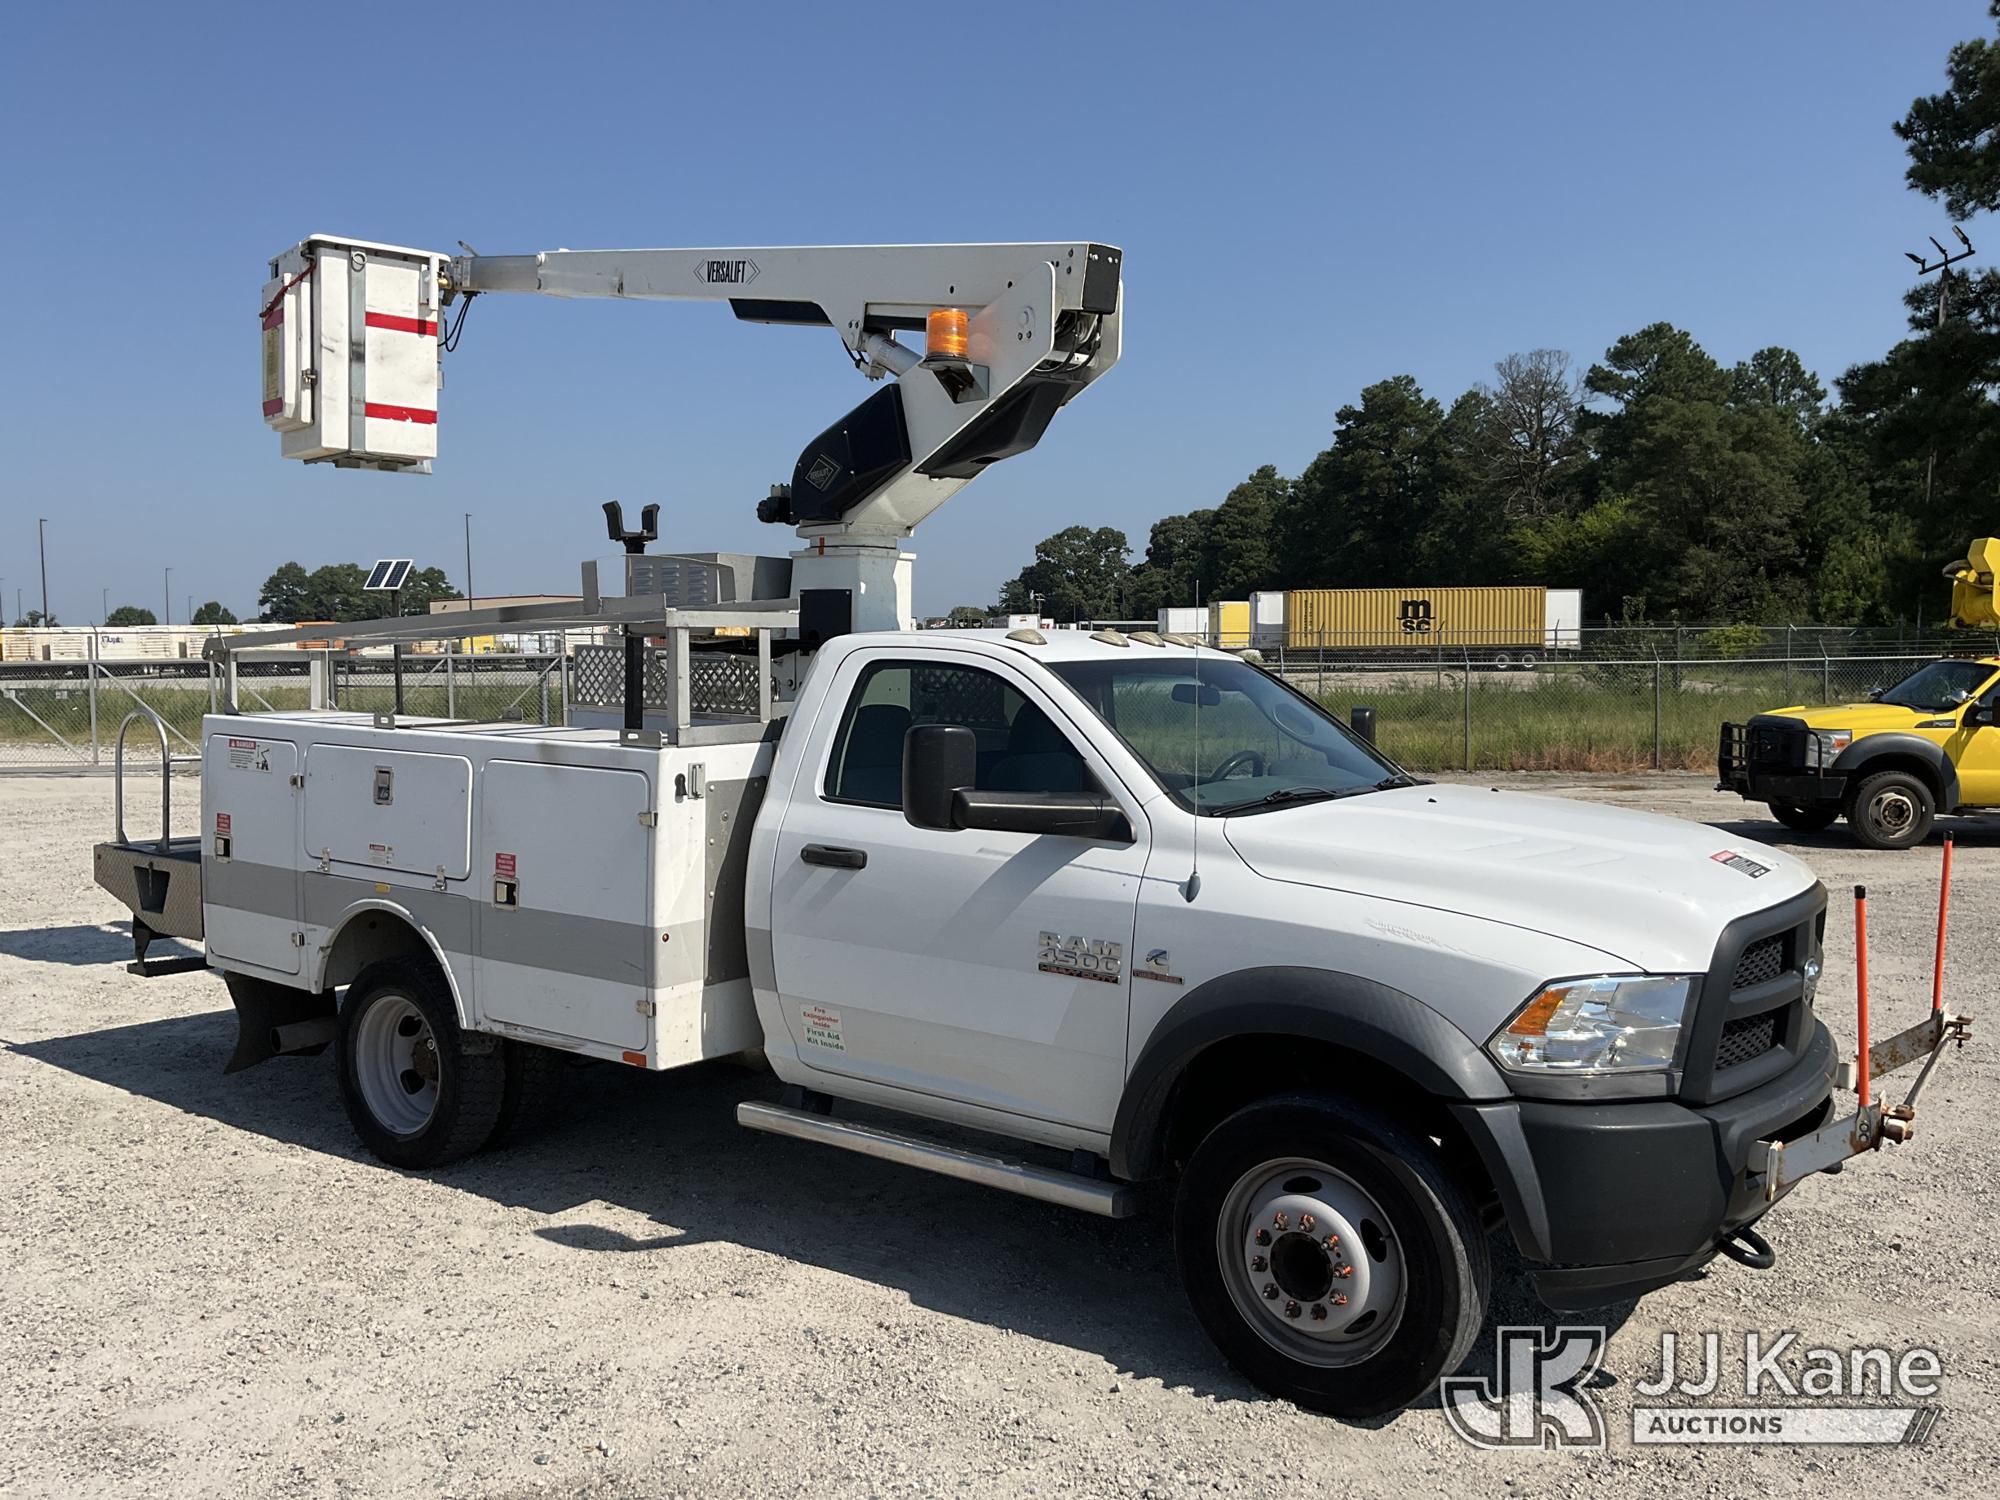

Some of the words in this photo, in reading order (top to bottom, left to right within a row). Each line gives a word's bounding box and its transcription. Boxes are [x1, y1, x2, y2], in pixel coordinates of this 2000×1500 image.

[707, 260, 746, 283] VERSALIFT
[1039, 931, 1122, 958] RAM
[1038, 948, 1122, 974] 4500
[807, 1028, 825, 1038] First
[827, 1032, 840, 1040] Aid
[807, 1037, 819, 1045] Kit
[820, 1040, 845, 1051] Inside
